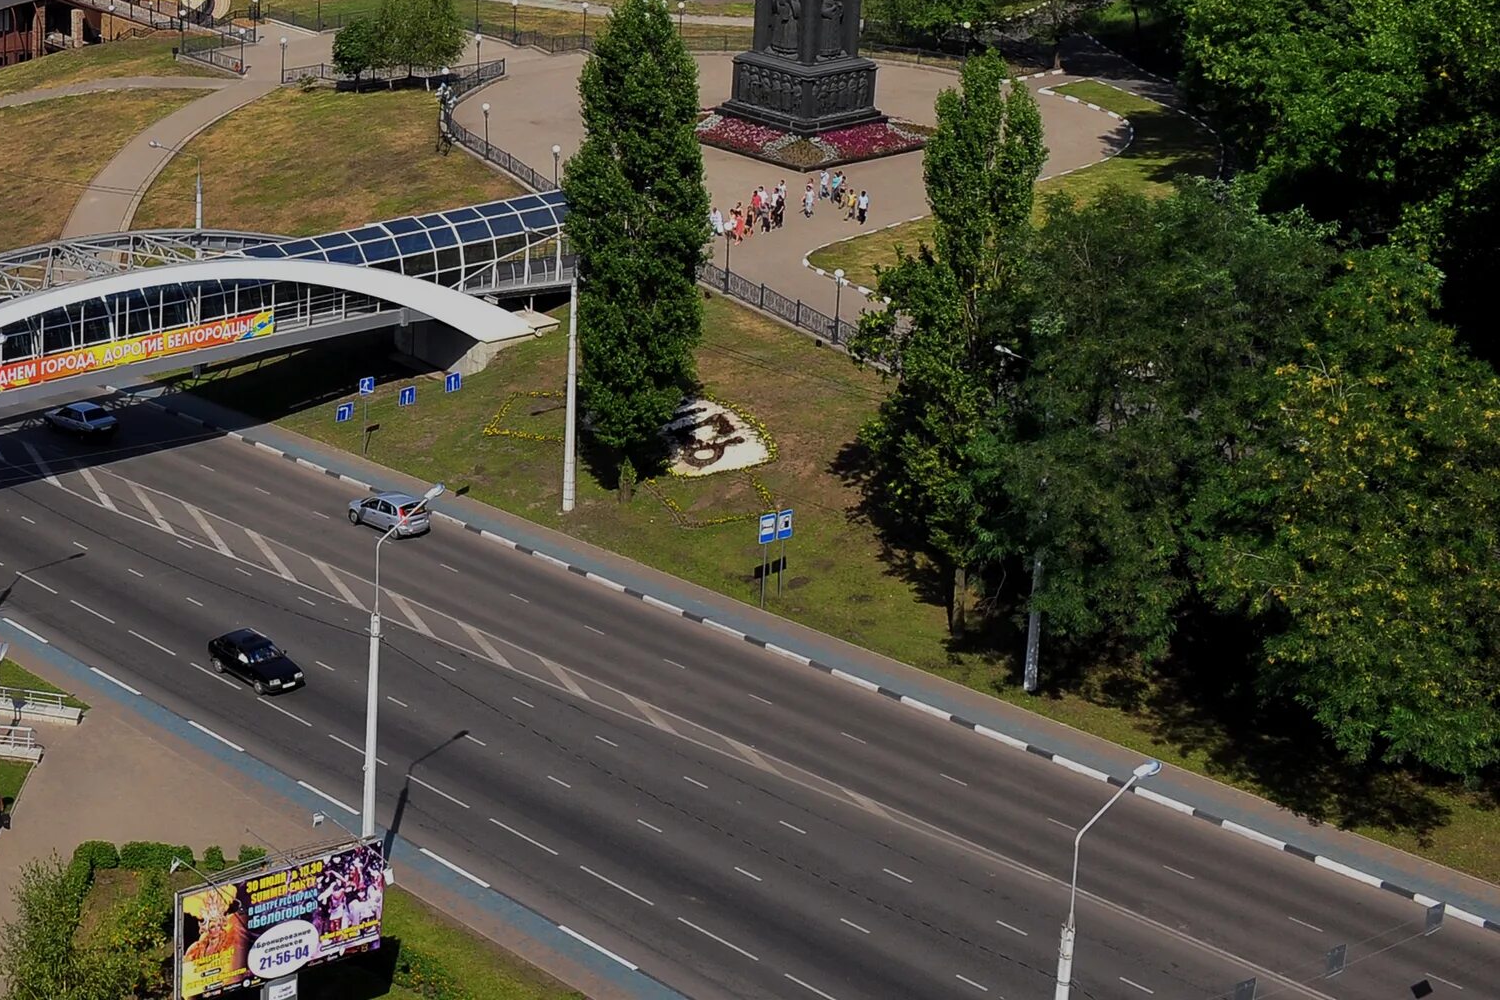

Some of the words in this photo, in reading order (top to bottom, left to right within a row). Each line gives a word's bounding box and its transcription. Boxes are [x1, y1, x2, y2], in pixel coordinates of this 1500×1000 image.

[40, 353, 99, 381] ГОРОДА,
[102, 337, 164, 363] ДОРОГИЕ
[167, 316, 255, 350] БЕЛГОРОДЦЫ!
[246, 880, 259, 893] 30
[259, 871, 287, 889] ИЮЛЯ
[250, 884, 288, 904] SUMMER
[289, 876, 317, 892] PARTY
[254, 900, 278, 914] ШАТРЕ
[259, 944, 310, 971] 21-56-04
